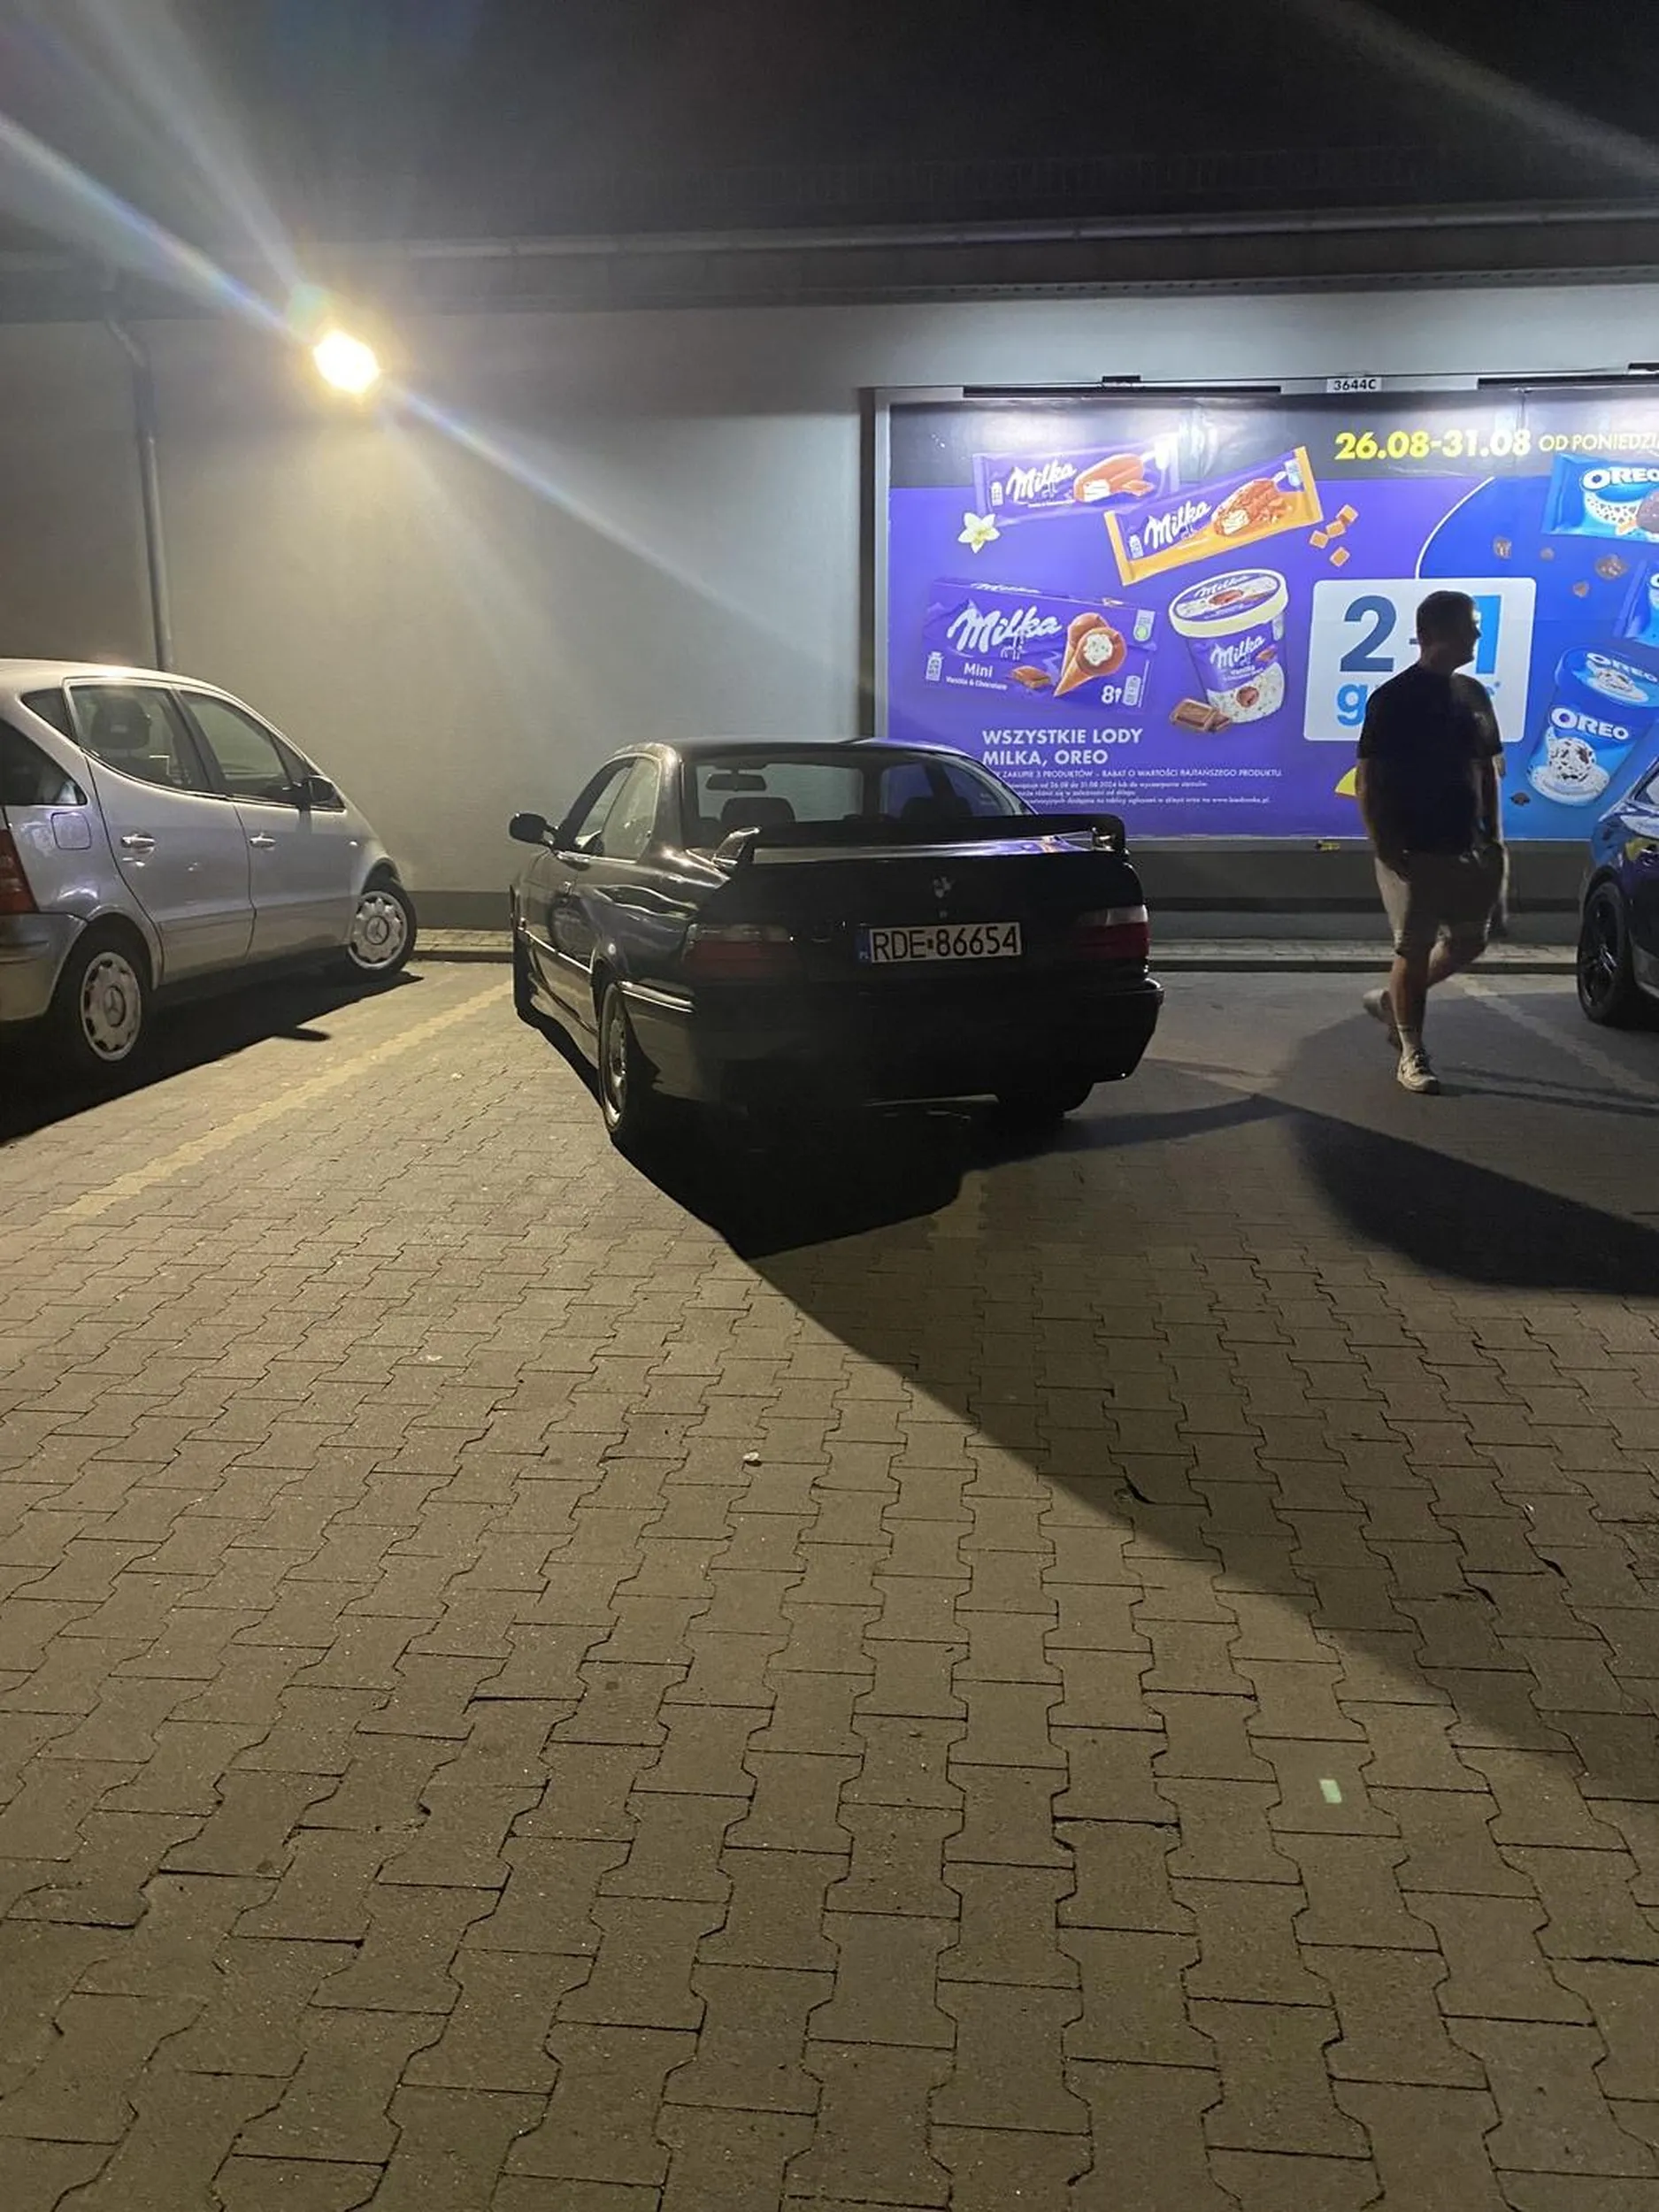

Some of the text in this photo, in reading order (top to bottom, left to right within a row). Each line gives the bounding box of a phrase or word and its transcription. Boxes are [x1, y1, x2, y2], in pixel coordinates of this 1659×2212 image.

[1333, 379, 1377, 390] 3644C
[1334, 429, 1531, 459] 26.08-31.08
[1539, 434, 1569, 451] OD
[1005, 459, 1077, 503] Milka
[1582, 467, 1659, 490] OREO
[1144, 501, 1212, 549] Milka
[947, 605, 1062, 653] Milka
[1210, 636, 1266, 668] Milka
[964, 663, 993, 678] Mini
[1586, 652, 1658, 683] OREO
[1102, 686, 1114, 704] 8
[982, 728, 1143, 744] WSZYSTKIE LODY
[1551, 708, 1628, 740] OREO
[982, 749, 1108, 766] MILKA, OREO
[872, 926, 1018, 961] RDE 86654
